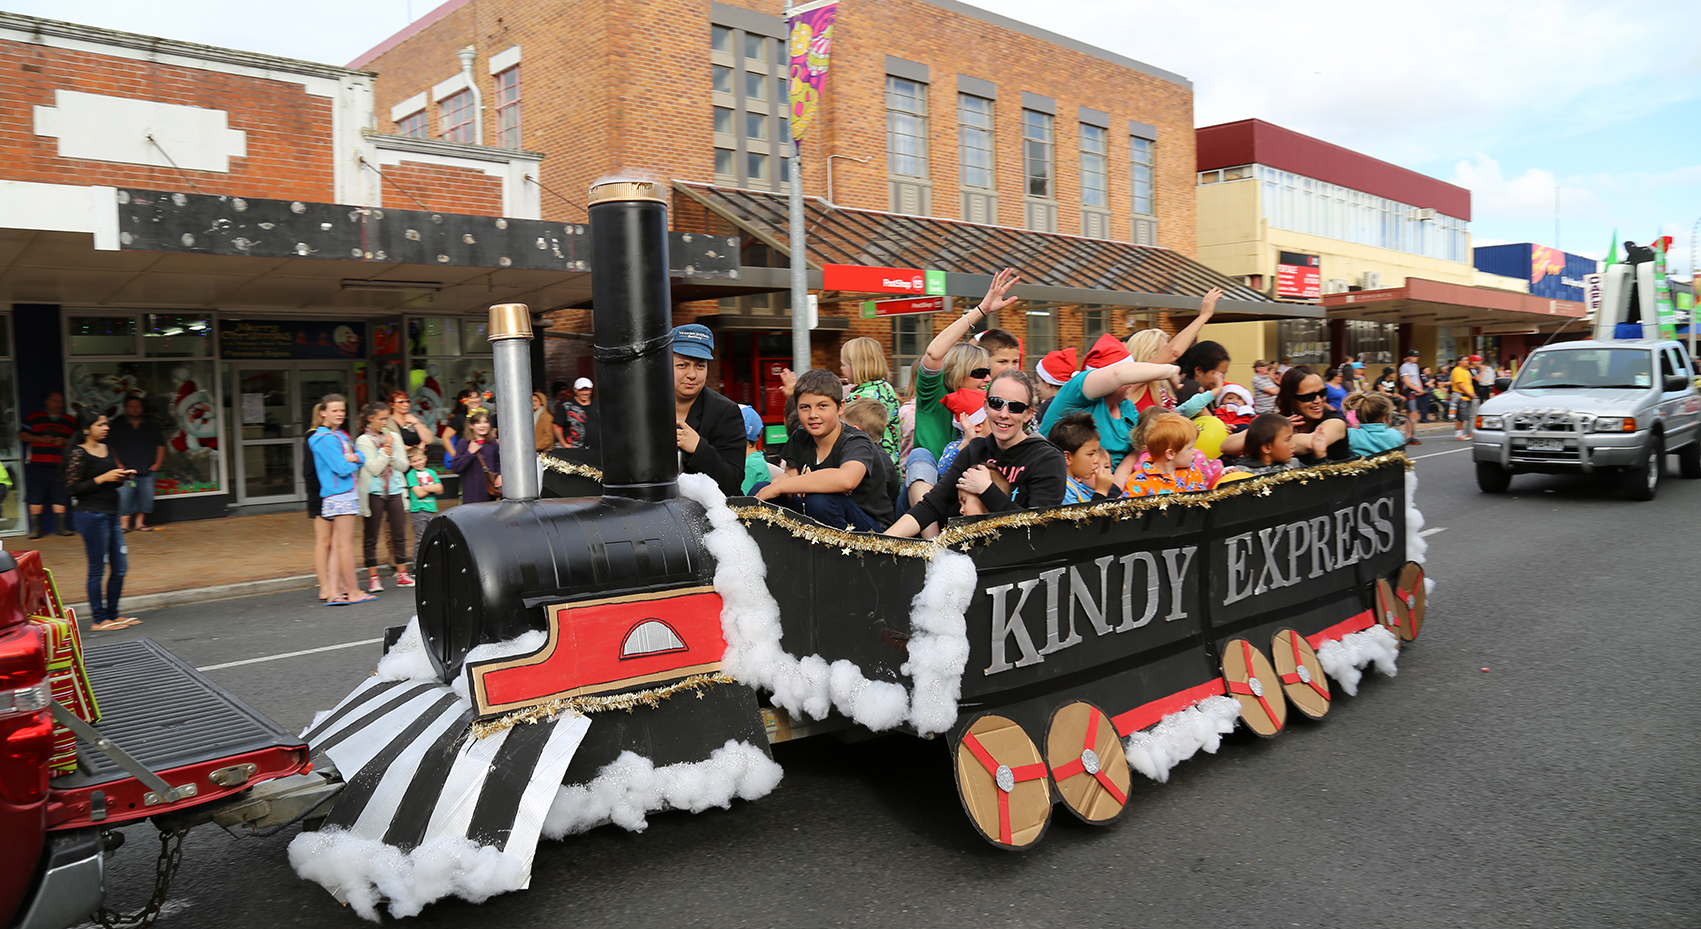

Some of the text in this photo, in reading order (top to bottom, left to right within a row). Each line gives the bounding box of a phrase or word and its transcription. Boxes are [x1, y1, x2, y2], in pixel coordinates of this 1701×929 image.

[1590, 276, 1602, 309] CAFE
[984, 497, 1396, 676] KINDY EXPRESS
